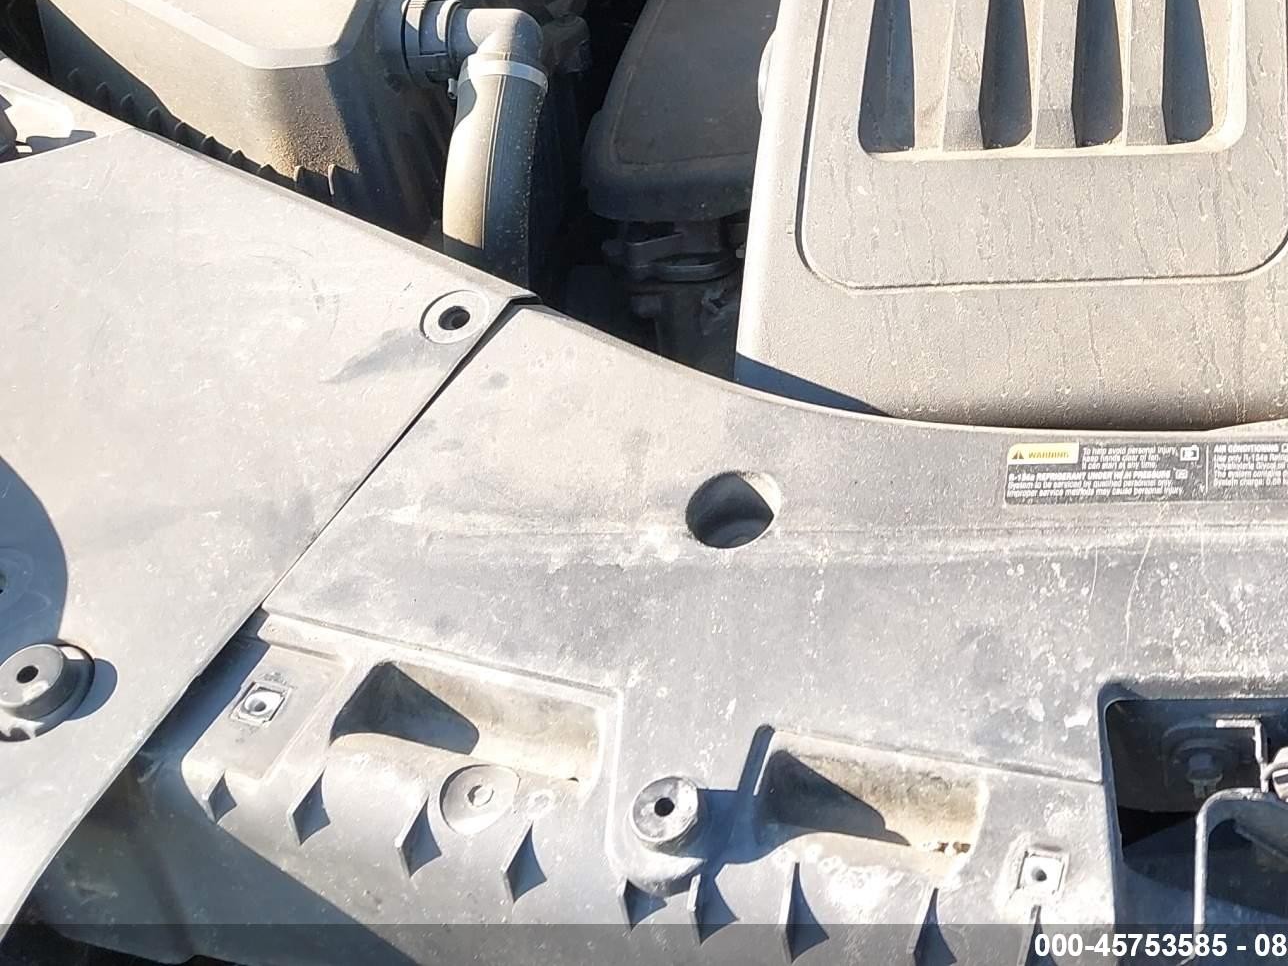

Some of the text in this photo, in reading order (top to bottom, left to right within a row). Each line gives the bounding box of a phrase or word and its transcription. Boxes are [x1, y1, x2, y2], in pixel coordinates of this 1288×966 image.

[1127, 446, 1155, 454] personal
[1036, 472, 1085, 481] REFRIGERANT
[1087, 472, 1112, 480] UNDER
[1133, 471, 1171, 479] PRESSURE
